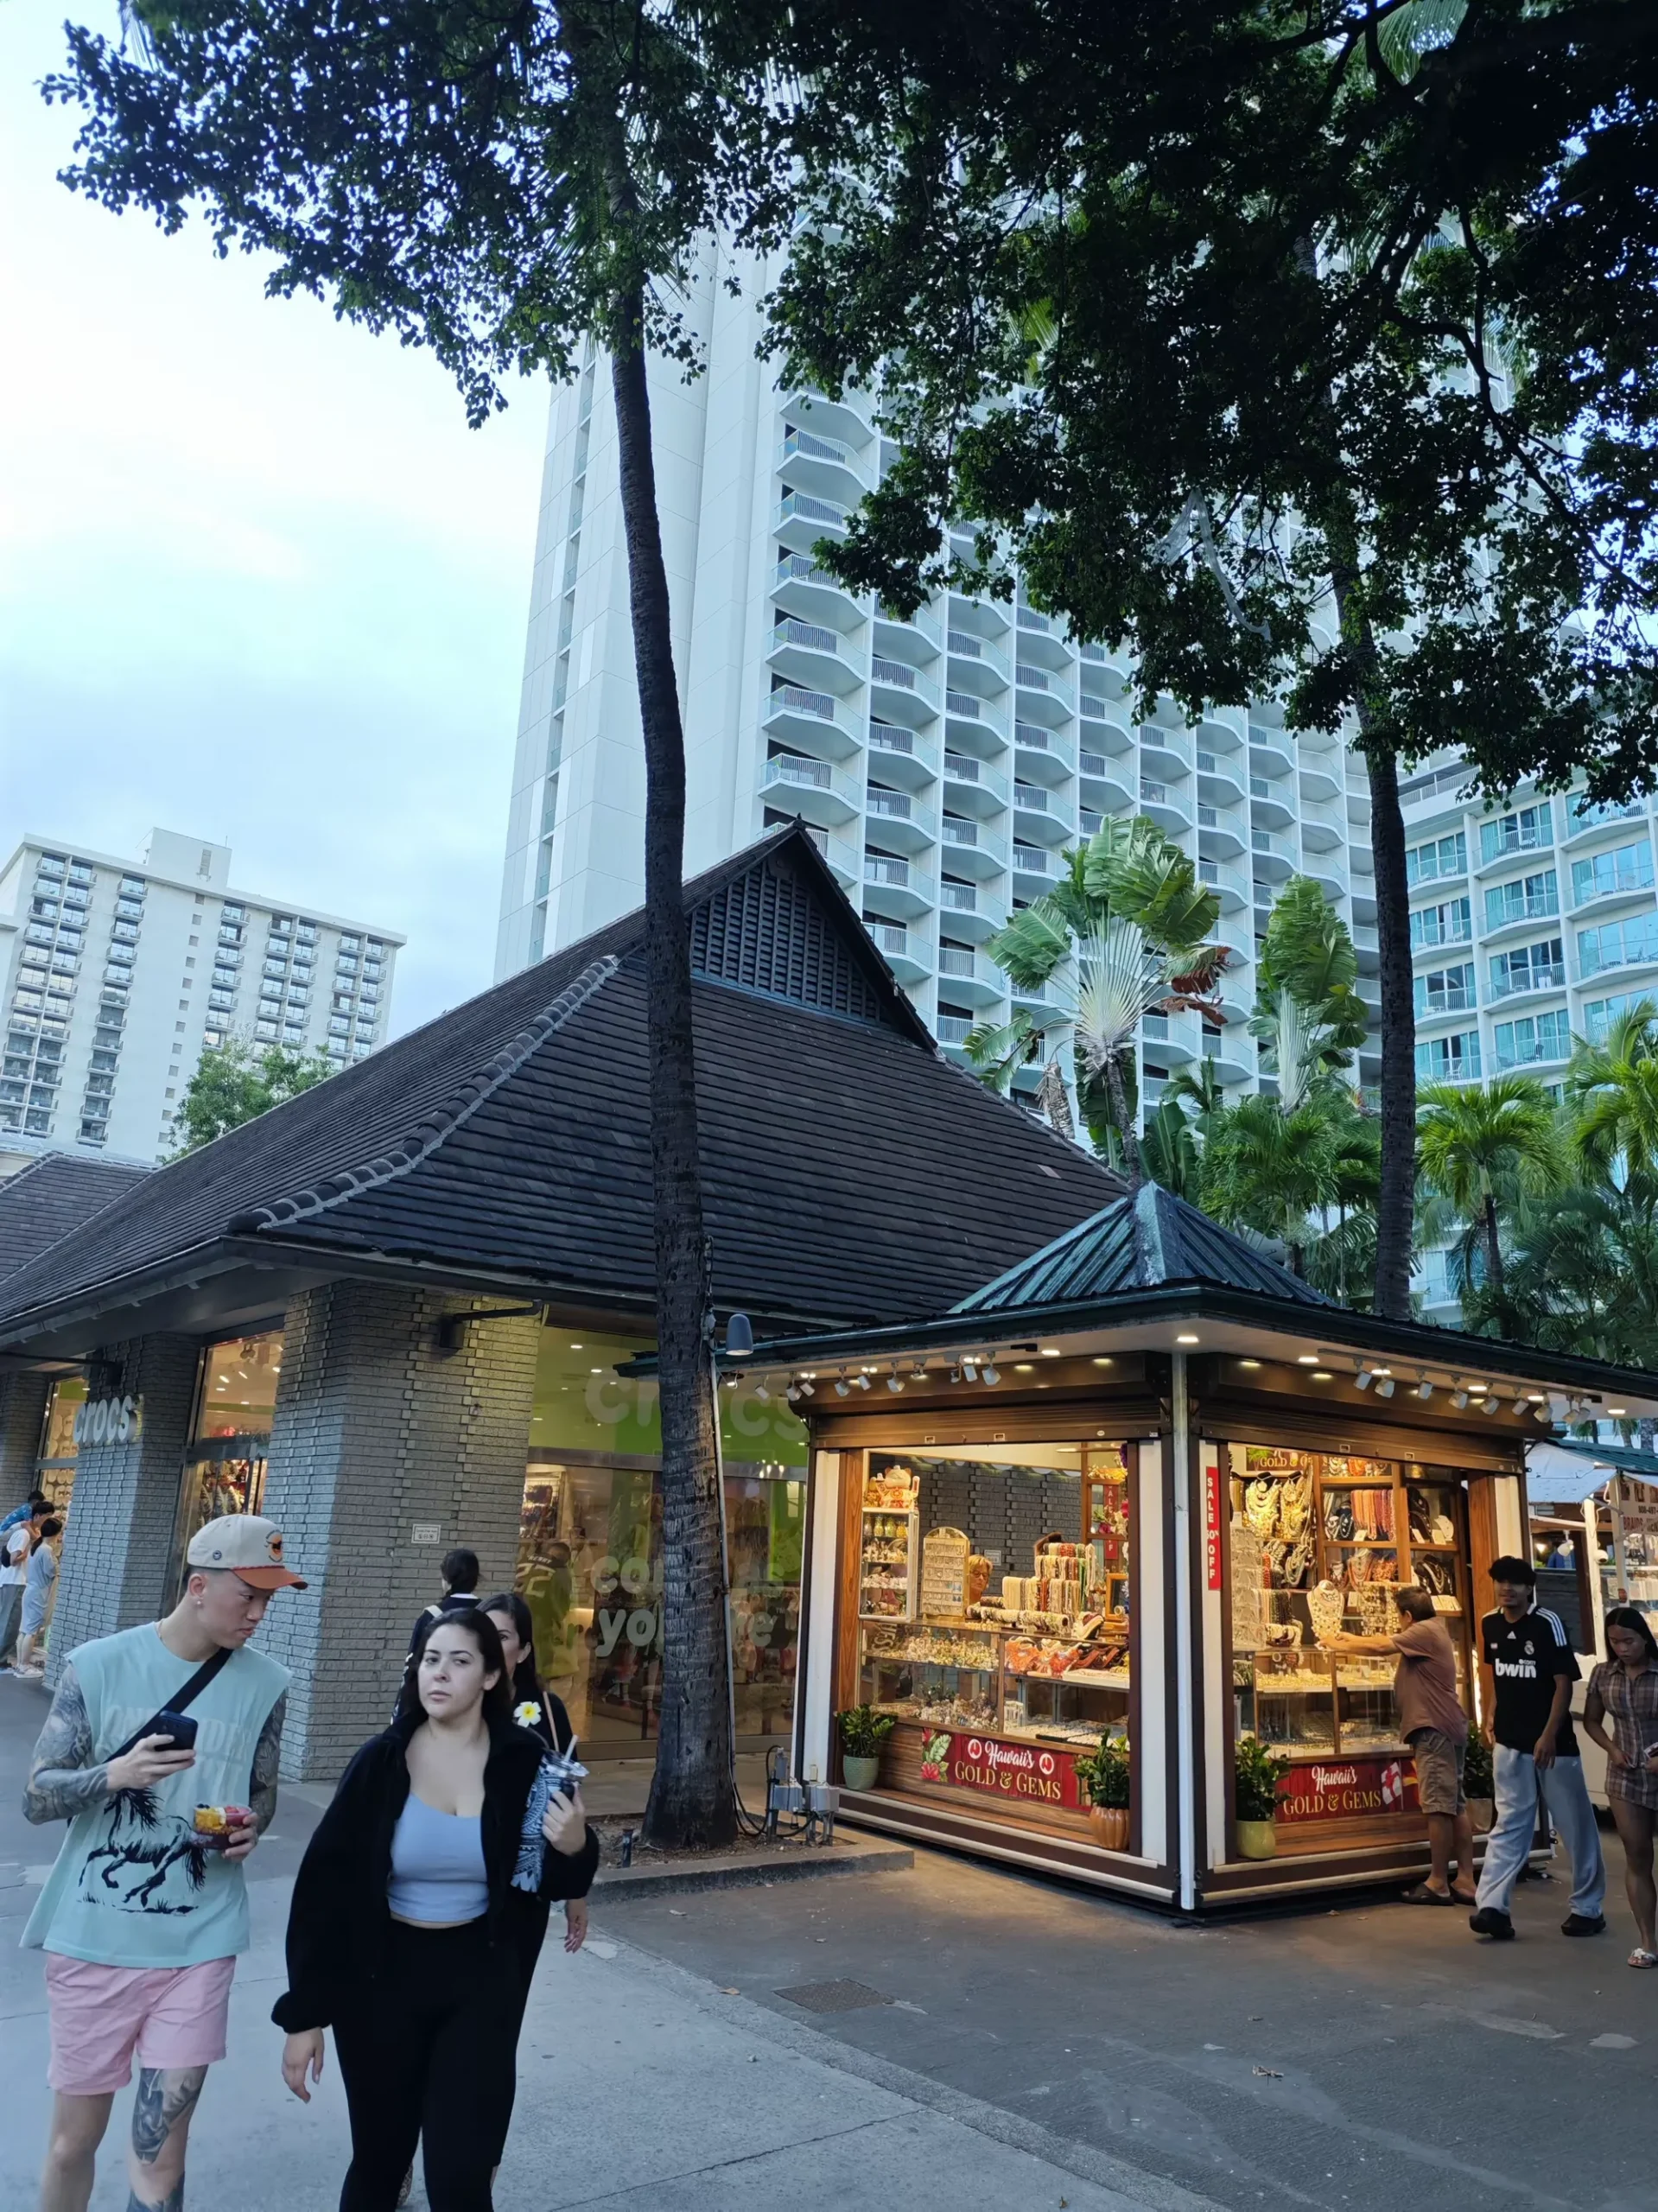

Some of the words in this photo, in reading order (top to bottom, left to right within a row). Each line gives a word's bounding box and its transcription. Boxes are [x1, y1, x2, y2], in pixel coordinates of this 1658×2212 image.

[73, 1395, 132, 1444] crocs
[585, 1370, 809, 1441] crcs
[1260, 1457, 1287, 1467] GOLD
[590, 1555, 665, 1594] co
[1208, 1544, 1217, 1580] OFF
[595, 1608, 664, 1657] yo
[1495, 1658, 1536, 1678] bwin
[984, 1740, 1035, 1770] Hawaii's
[955, 1760, 995, 1786] GOLD
[1000, 1771, 1013, 1789] &
[1016, 1772, 1061, 1800] GEMS
[1311, 1764, 1358, 1795] Hawaii's
[1283, 1795, 1324, 1815] GOLD
[1327, 1793, 1339, 1812] &
[1342, 1789, 1382, 1810] GEMS
